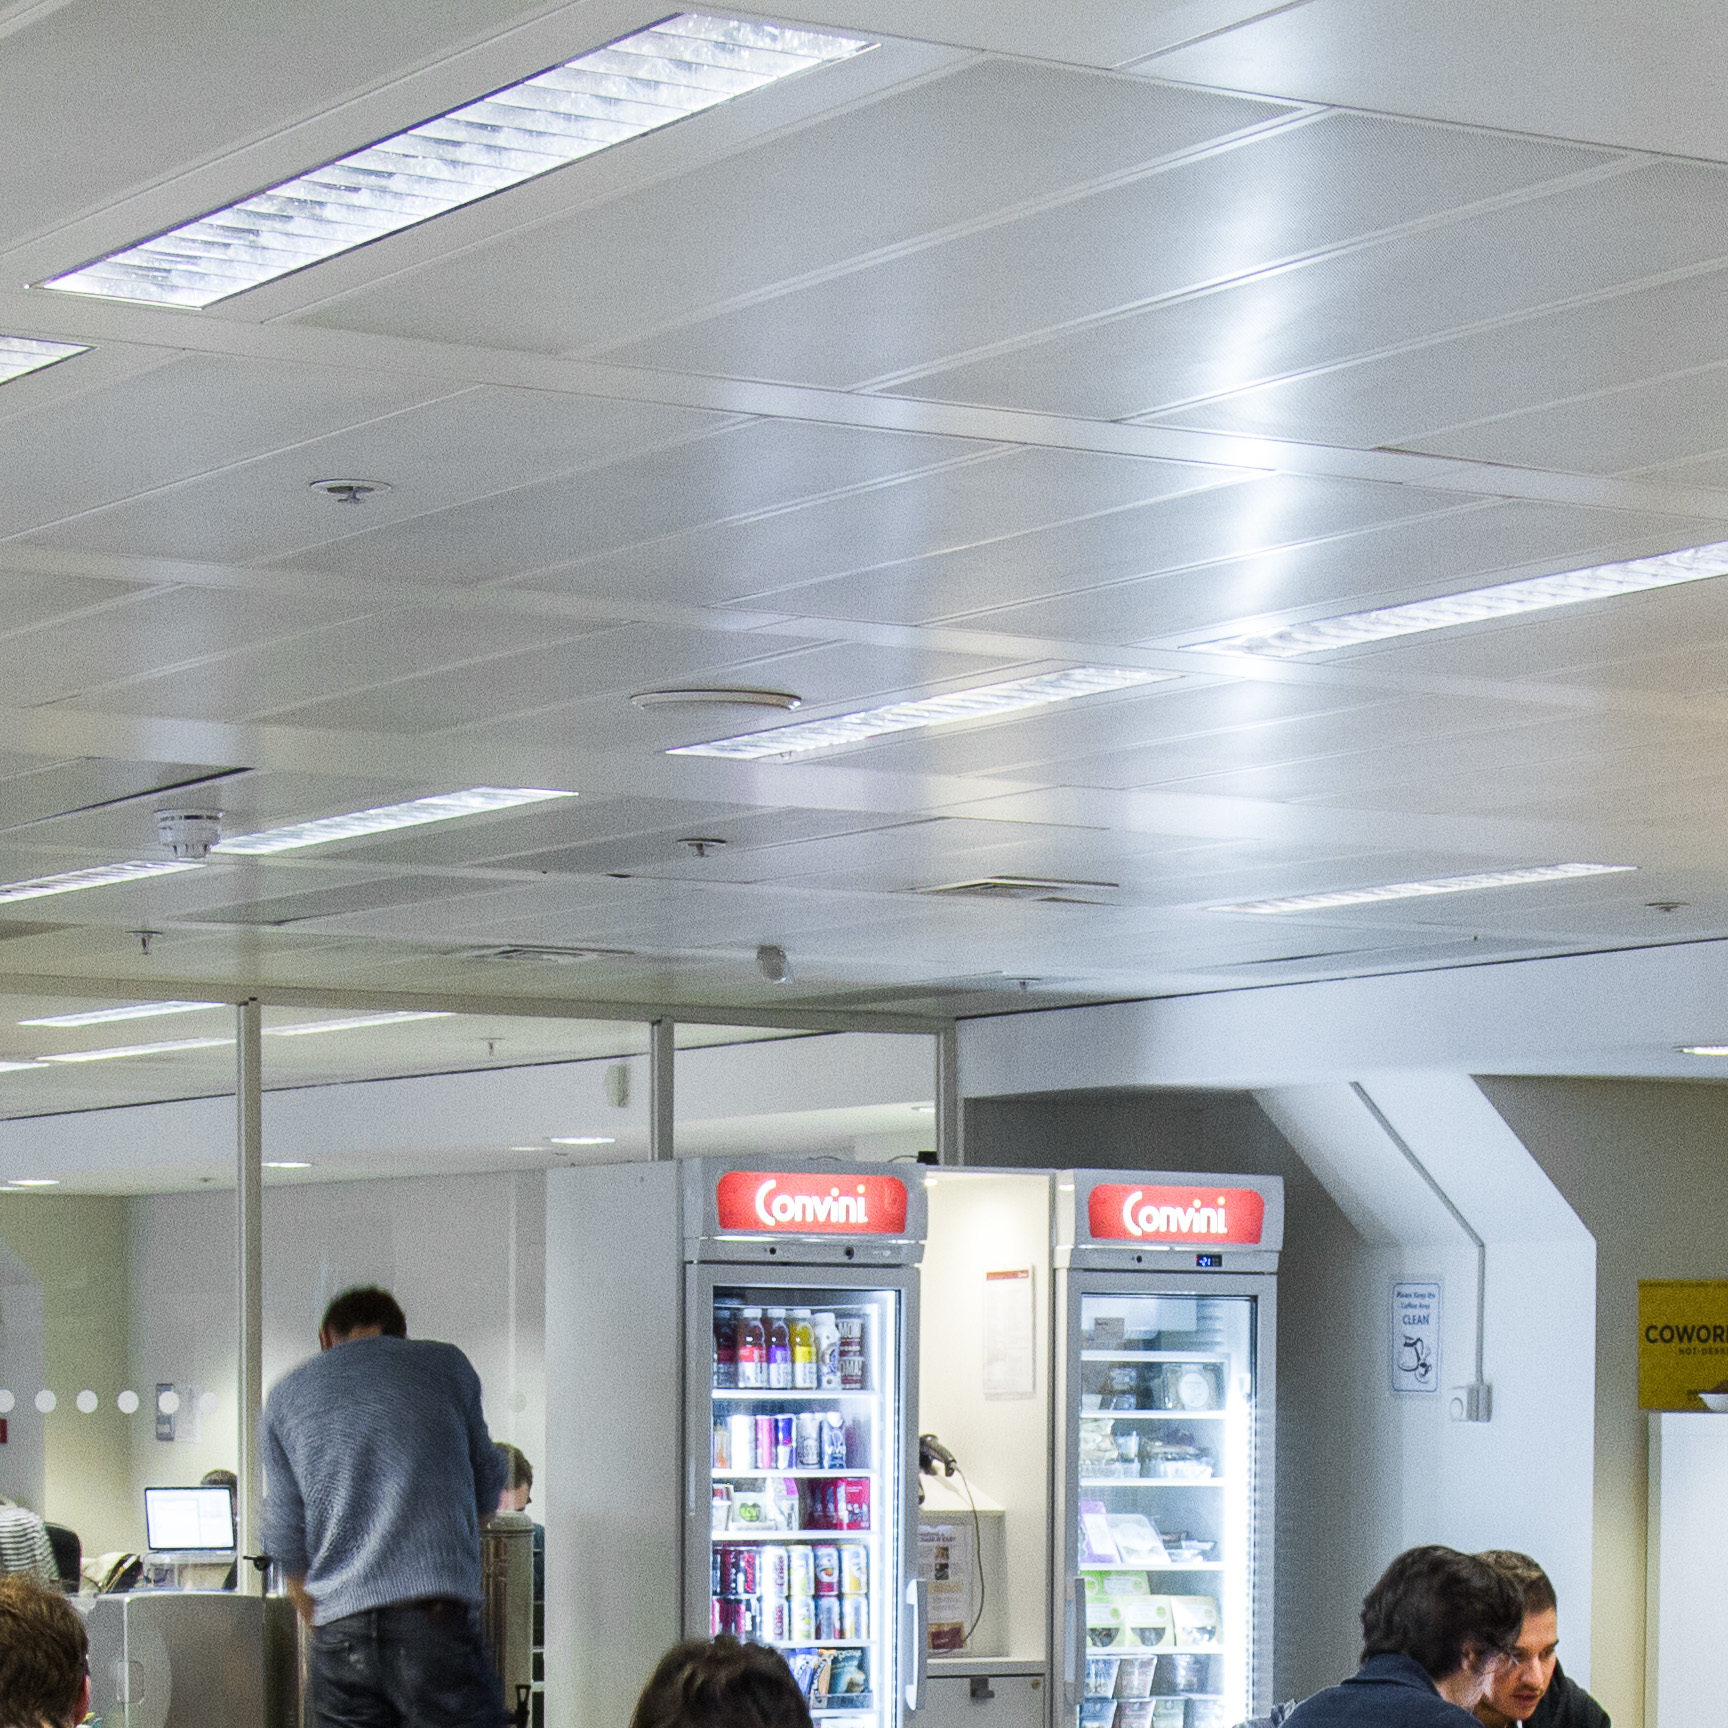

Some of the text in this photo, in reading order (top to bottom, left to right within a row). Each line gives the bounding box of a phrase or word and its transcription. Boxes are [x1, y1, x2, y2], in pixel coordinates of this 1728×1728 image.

[755, 1179, 869, 1227] Convini
[1122, 1190, 1228, 1237] Convini
[1402, 1314, 1429, 1325] CLEAN
